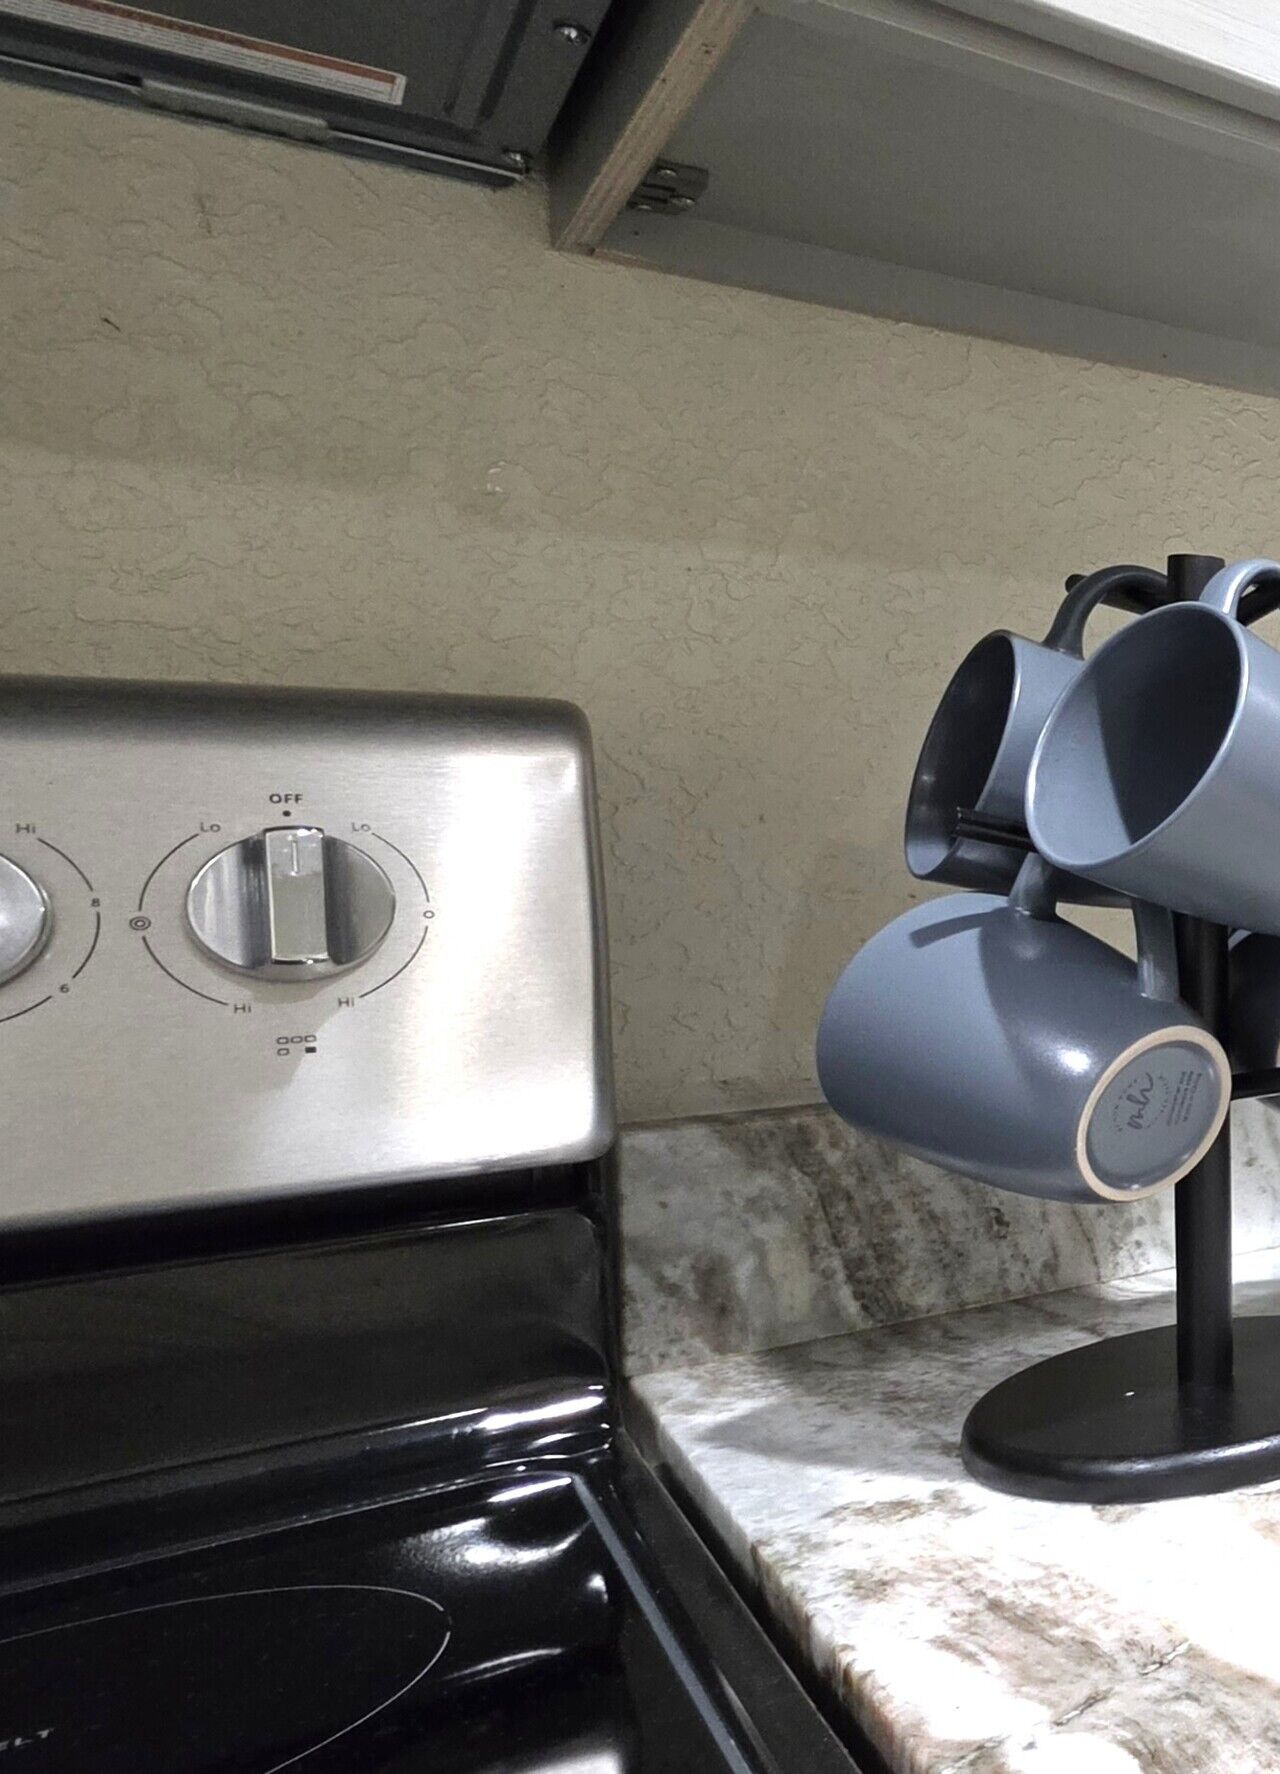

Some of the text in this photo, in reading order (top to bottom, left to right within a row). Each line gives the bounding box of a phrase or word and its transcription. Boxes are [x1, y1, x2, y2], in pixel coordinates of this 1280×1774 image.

[269, 793, 303, 804] OFF
[16, 823, 36, 834] Hi
[200, 821, 221, 833] Lo
[351, 821, 372, 833] Lo
[60, 983, 70, 994] 6
[338, 997, 355, 1008] Hi
[234, 1003, 252, 1014] Hi
